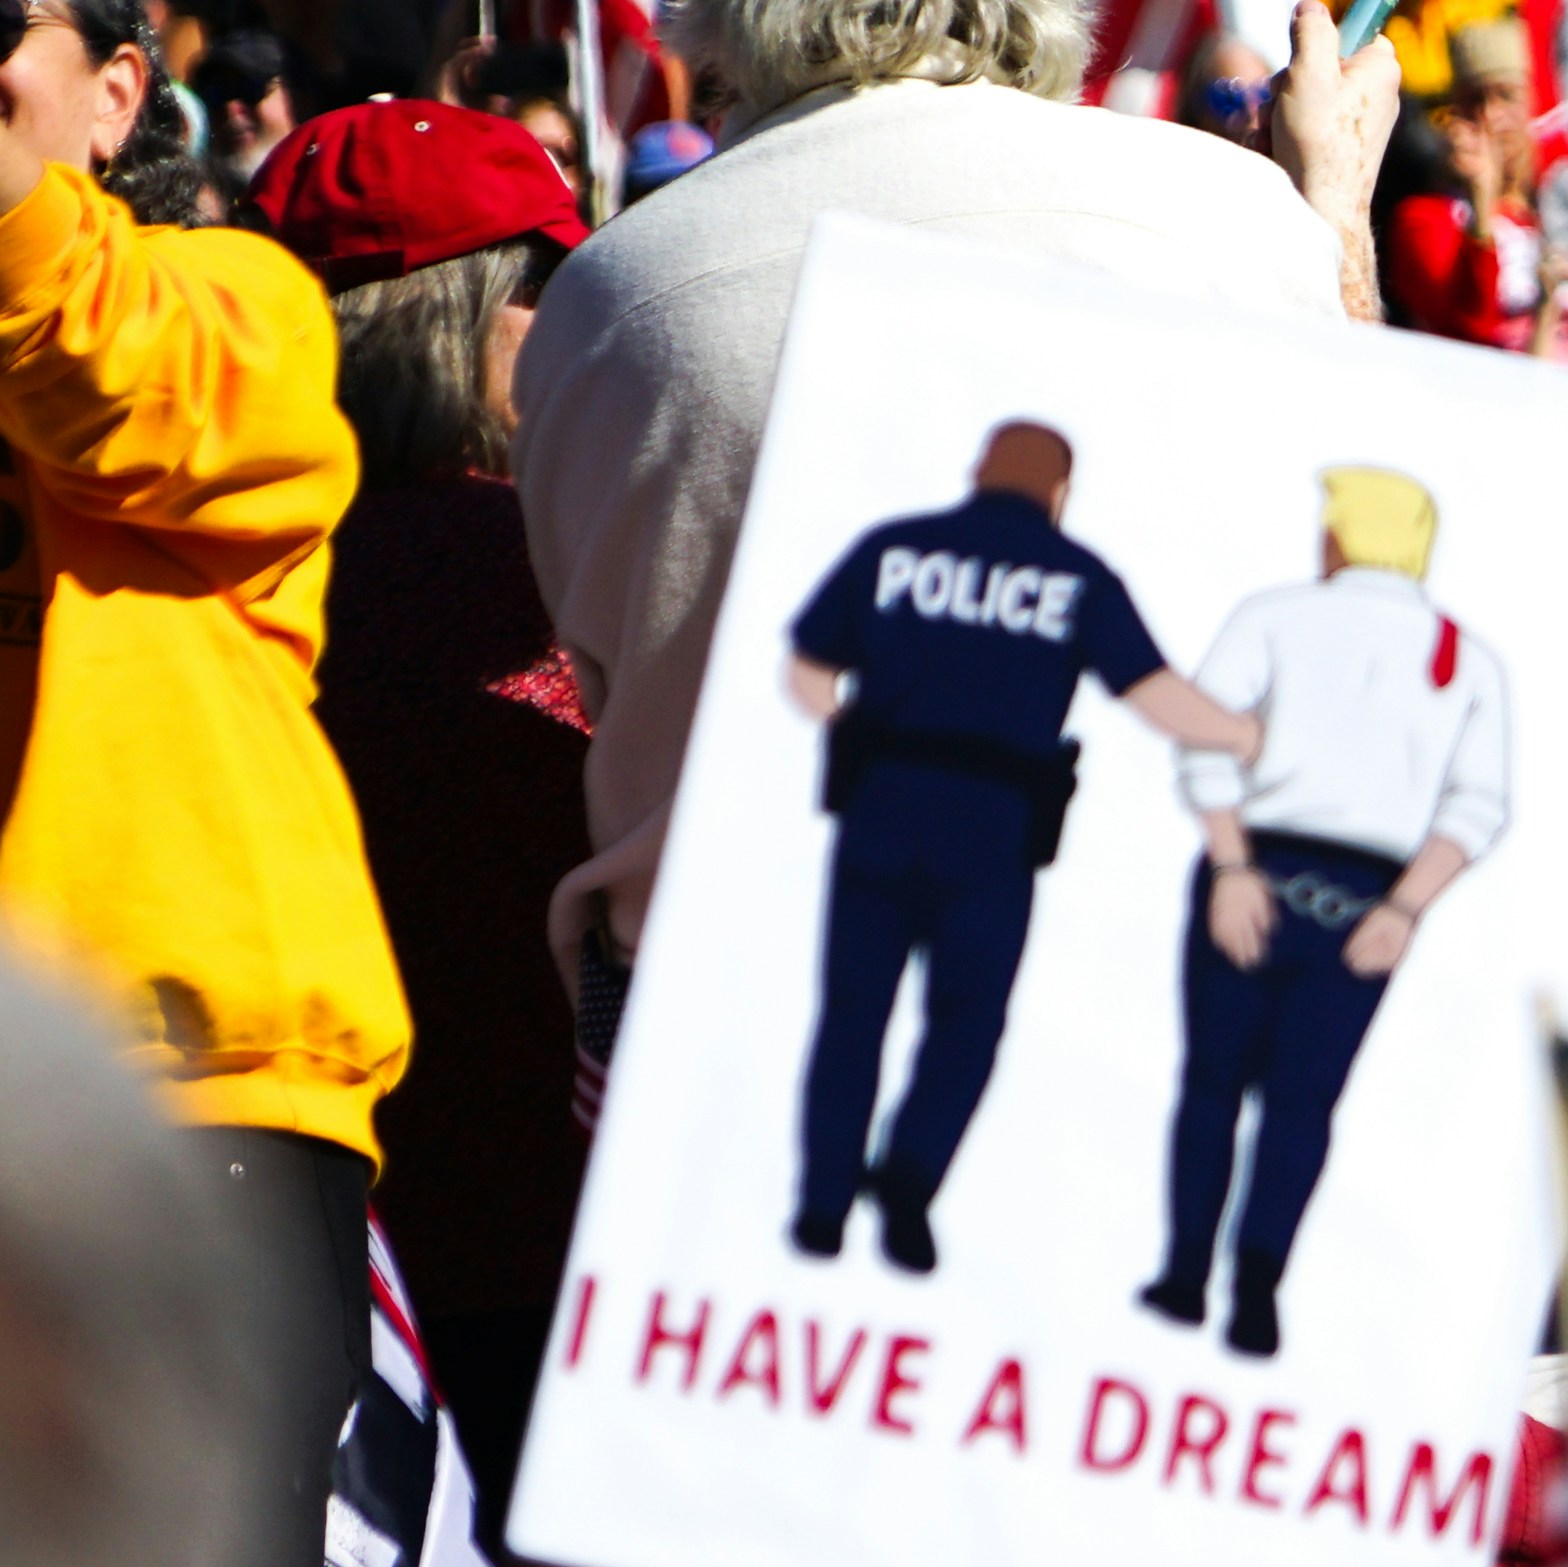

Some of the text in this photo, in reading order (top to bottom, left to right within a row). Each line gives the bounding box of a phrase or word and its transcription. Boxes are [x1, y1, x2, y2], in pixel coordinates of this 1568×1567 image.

[874, 547, 1087, 642] POLICE
[564, 1275, 1497, 1552] I HAVE A DREAM
